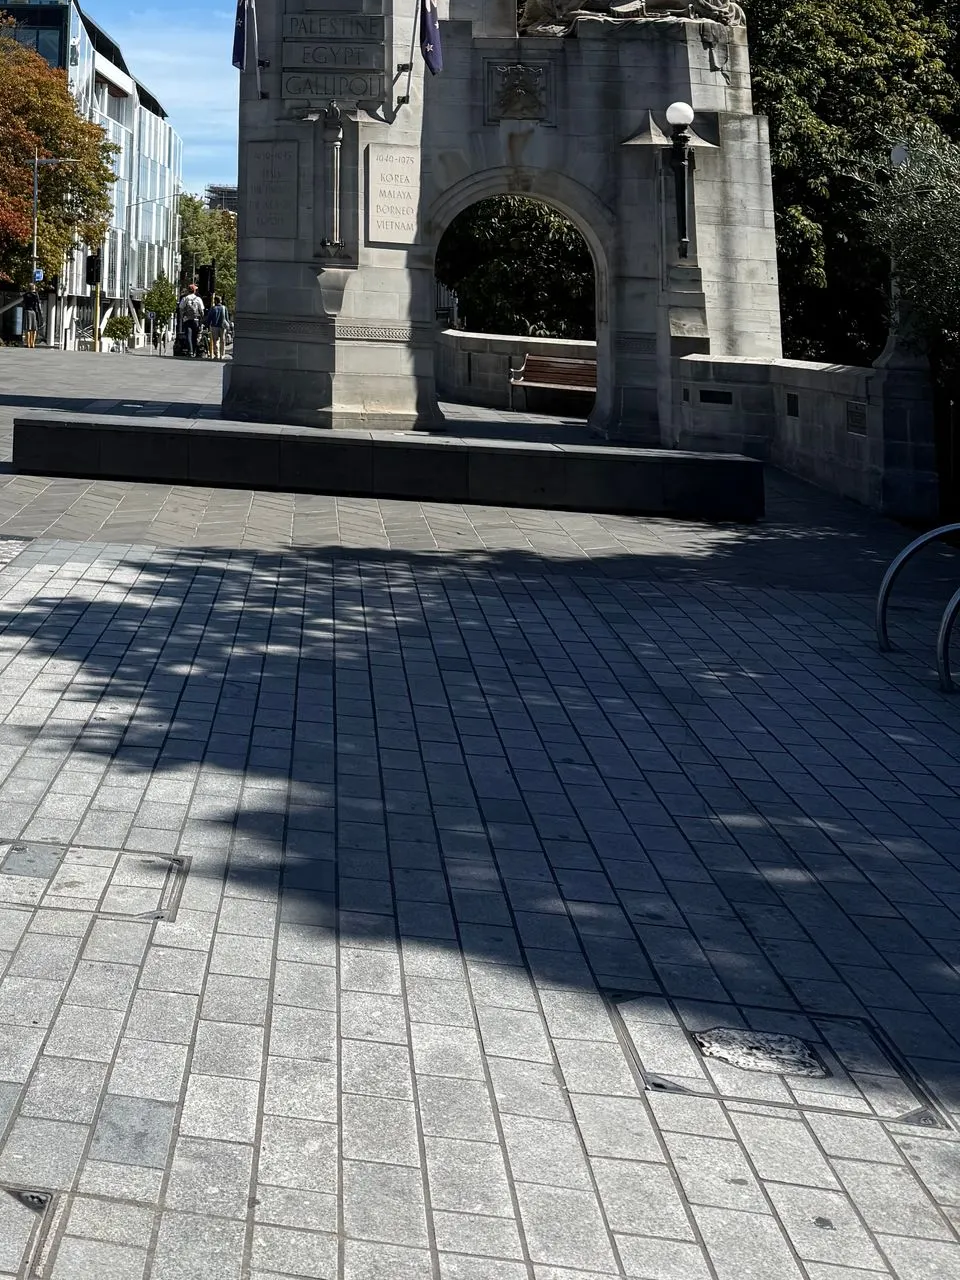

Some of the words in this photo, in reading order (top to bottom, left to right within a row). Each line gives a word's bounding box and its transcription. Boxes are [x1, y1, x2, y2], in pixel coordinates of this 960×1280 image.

[288, 17, 378, 35] PALESTINE
[303, 45, 365, 65] EGYPT
[285, 75, 381, 97] GALLIPOLI
[380, 172, 410, 184] KOREA
[378, 187, 413, 200] MALAYA
[376, 203, 415, 216] BORNEO
[376, 219, 415, 232] VIETNAM
